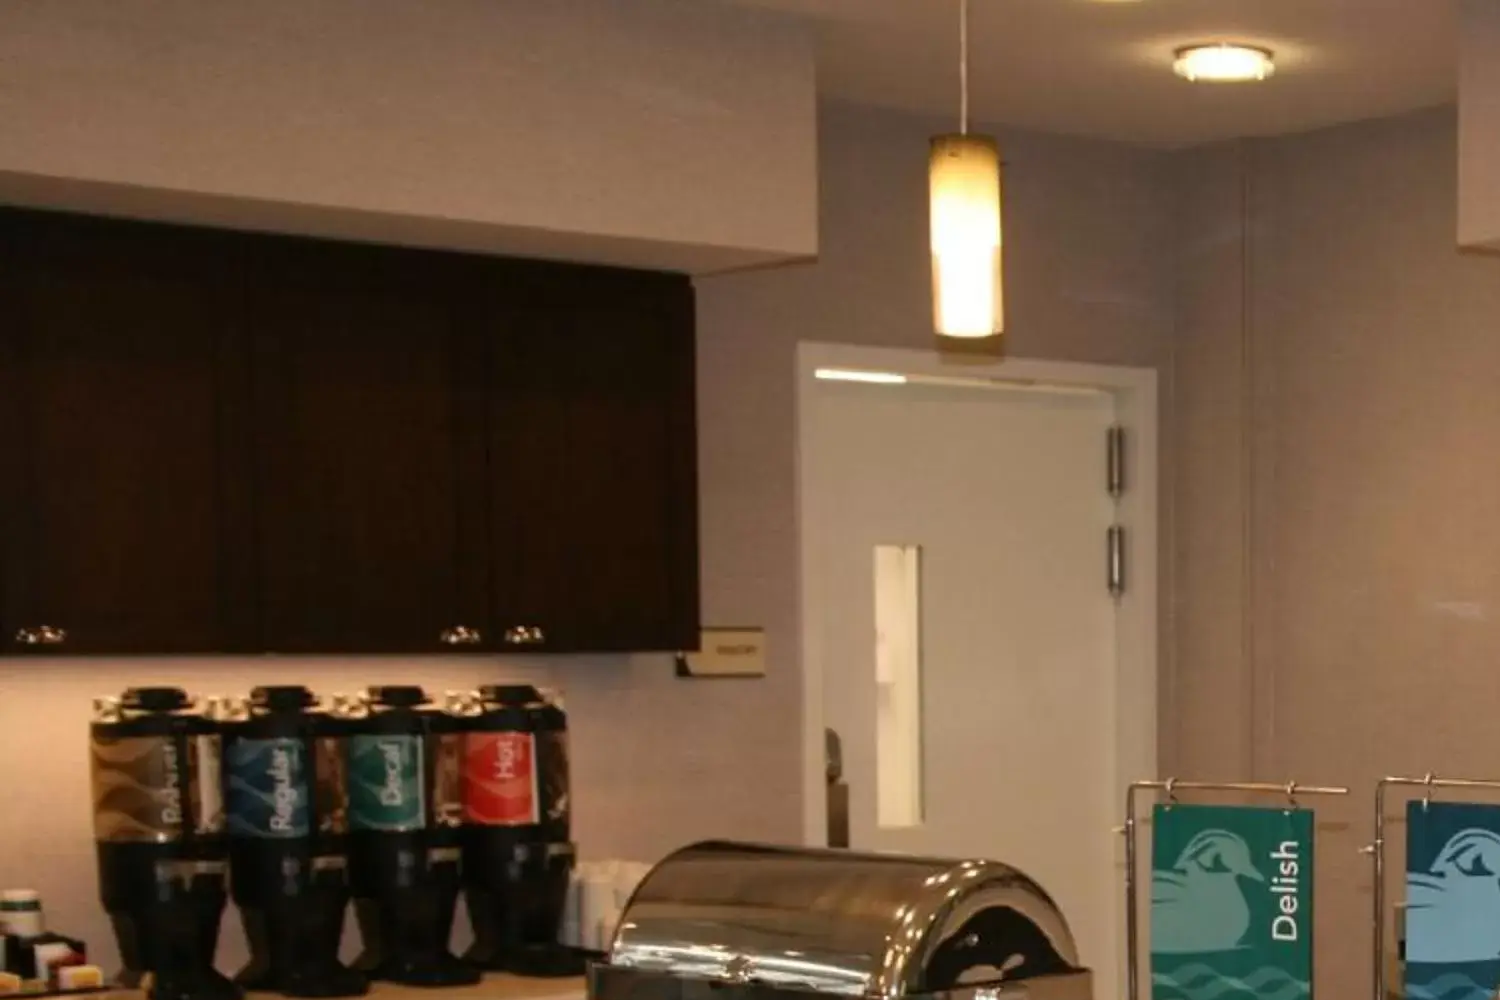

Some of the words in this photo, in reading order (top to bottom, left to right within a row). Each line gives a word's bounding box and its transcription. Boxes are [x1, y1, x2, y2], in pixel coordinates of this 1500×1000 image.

[266, 746, 298, 831] Regular
[378, 741, 403, 806] Decaf
[492, 740, 515, 779] Hot
[1269, 840, 1300, 941] Delish
